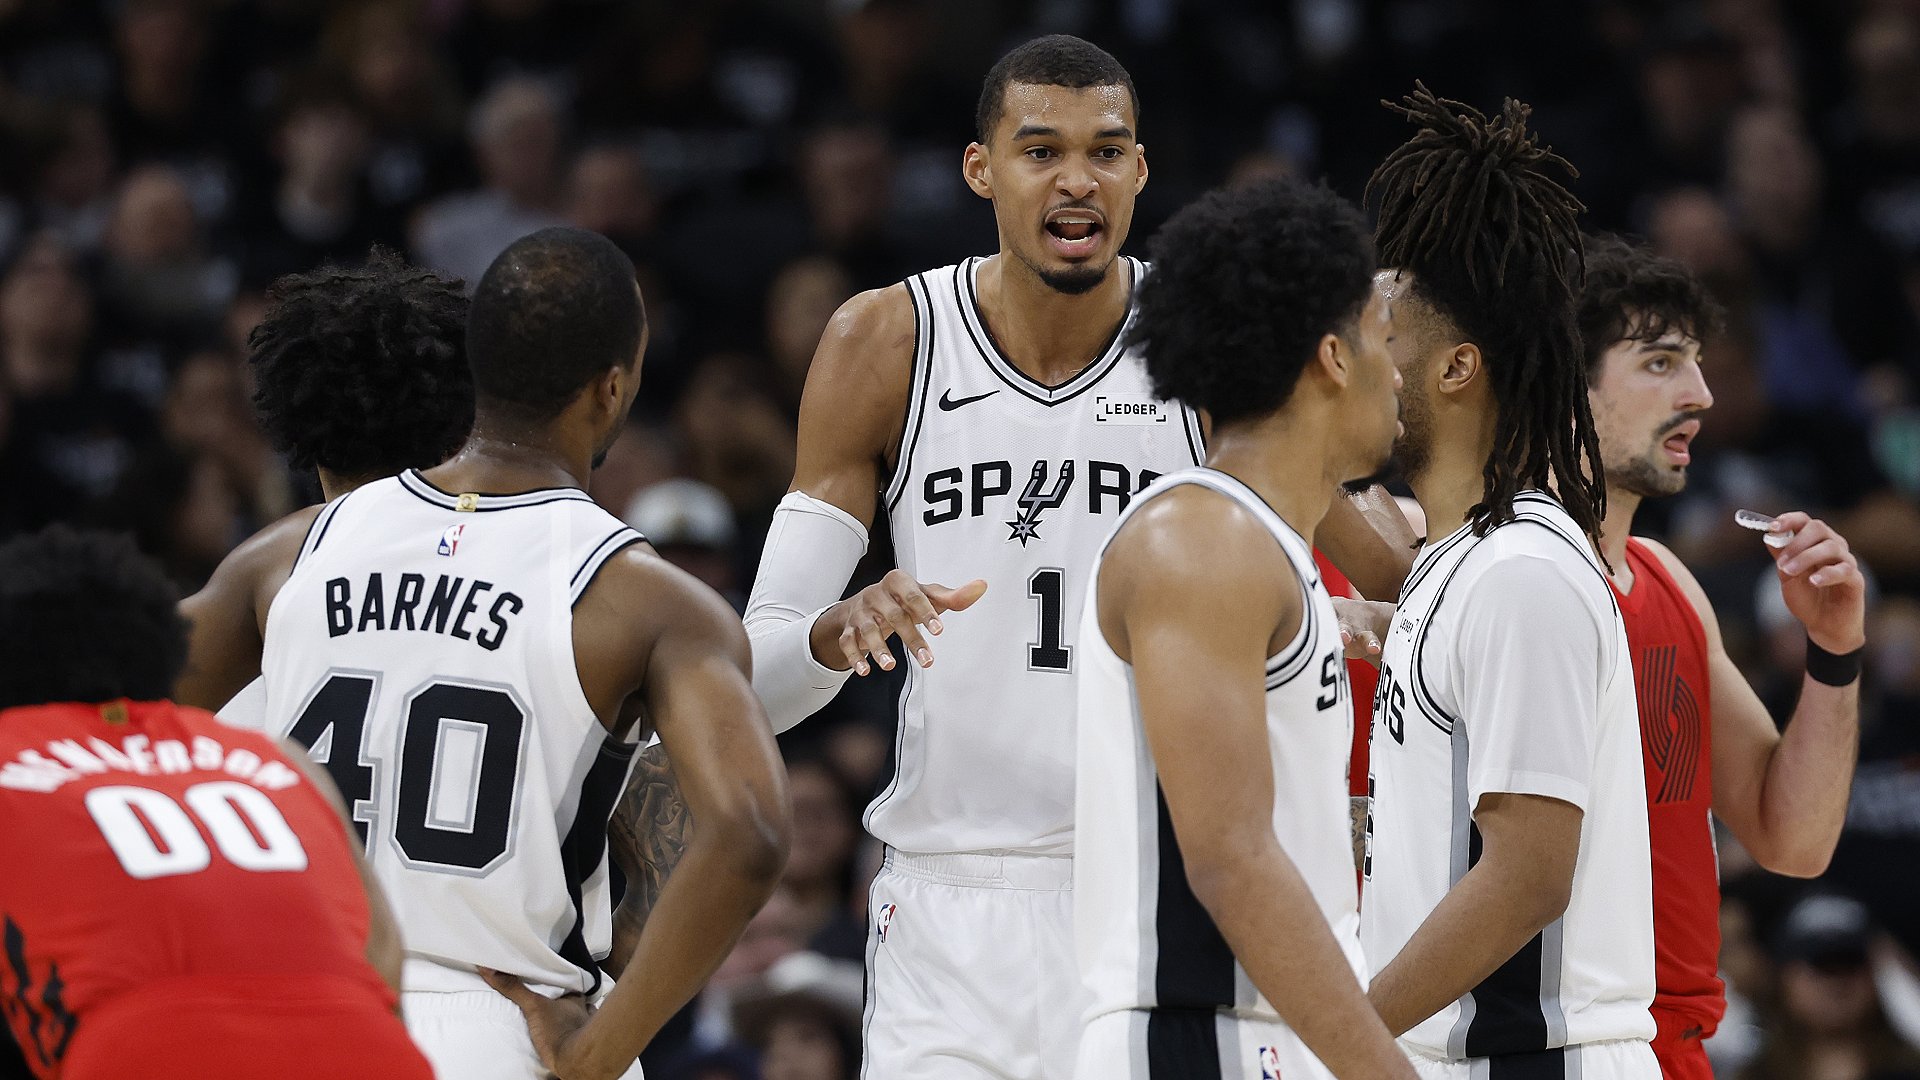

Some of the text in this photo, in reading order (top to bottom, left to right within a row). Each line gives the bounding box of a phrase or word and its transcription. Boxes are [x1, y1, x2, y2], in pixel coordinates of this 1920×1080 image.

[1105, 403, 1158, 416] LEDGER
[326, 572, 524, 652] BARNES
[1027, 567, 1073, 674] 1
[282, 666, 533, 879] 40
[85, 780, 309, 881] 00
